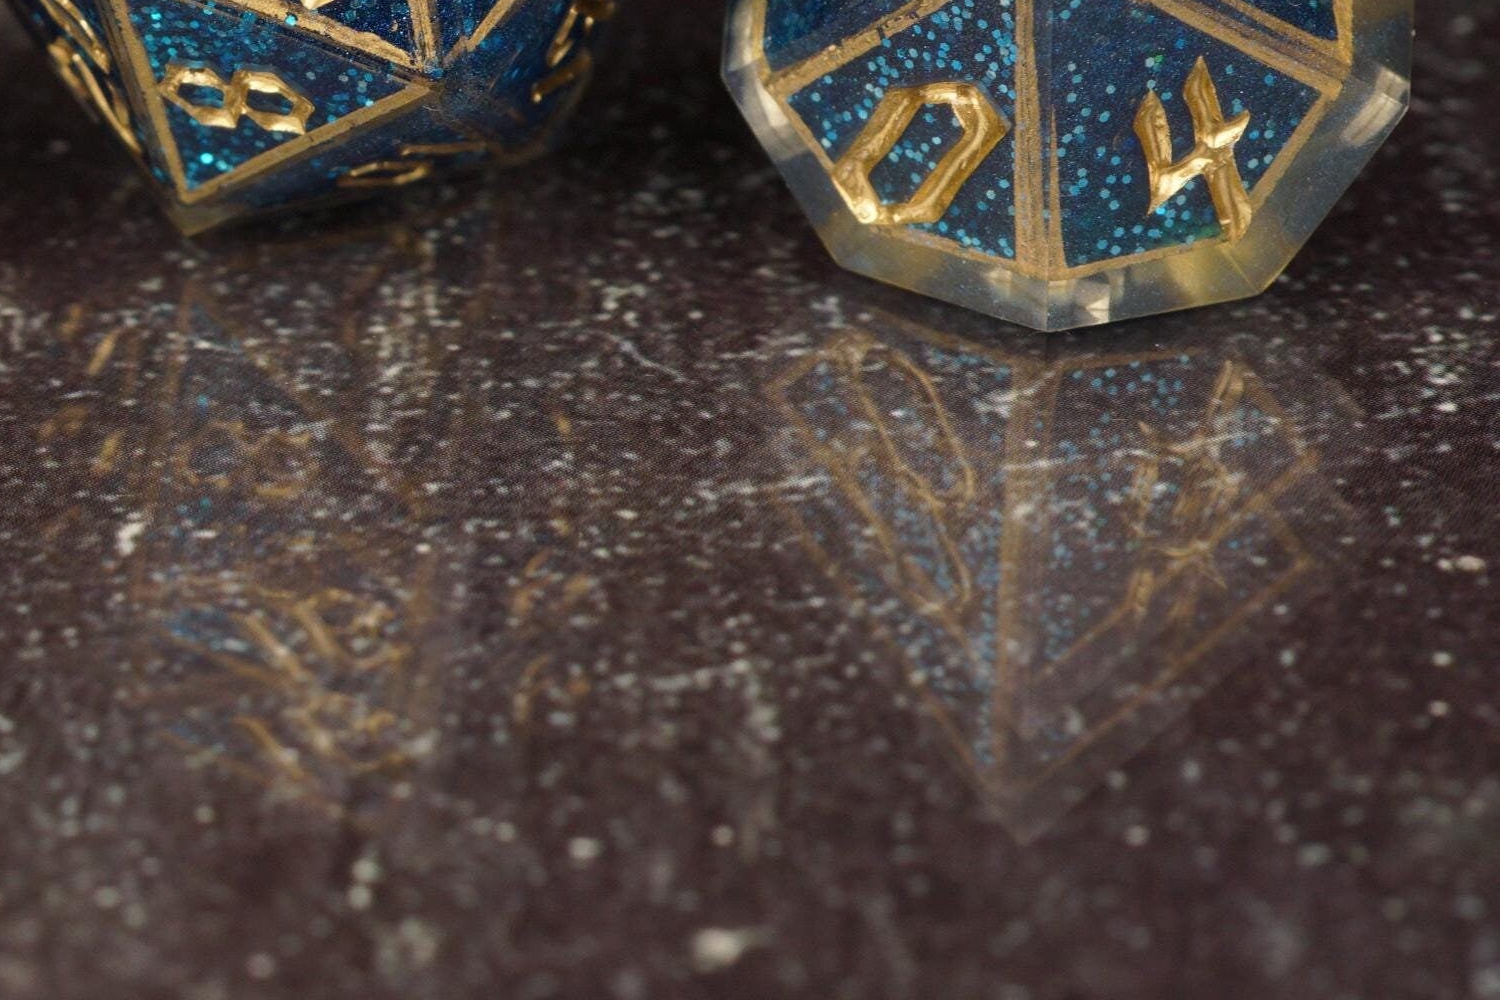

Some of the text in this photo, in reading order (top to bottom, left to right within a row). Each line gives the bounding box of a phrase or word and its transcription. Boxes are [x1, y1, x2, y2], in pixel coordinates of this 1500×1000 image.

[159, 61, 315, 135] 8
[832, 80, 1010, 225] 0
[1133, 54, 1252, 247] 4
